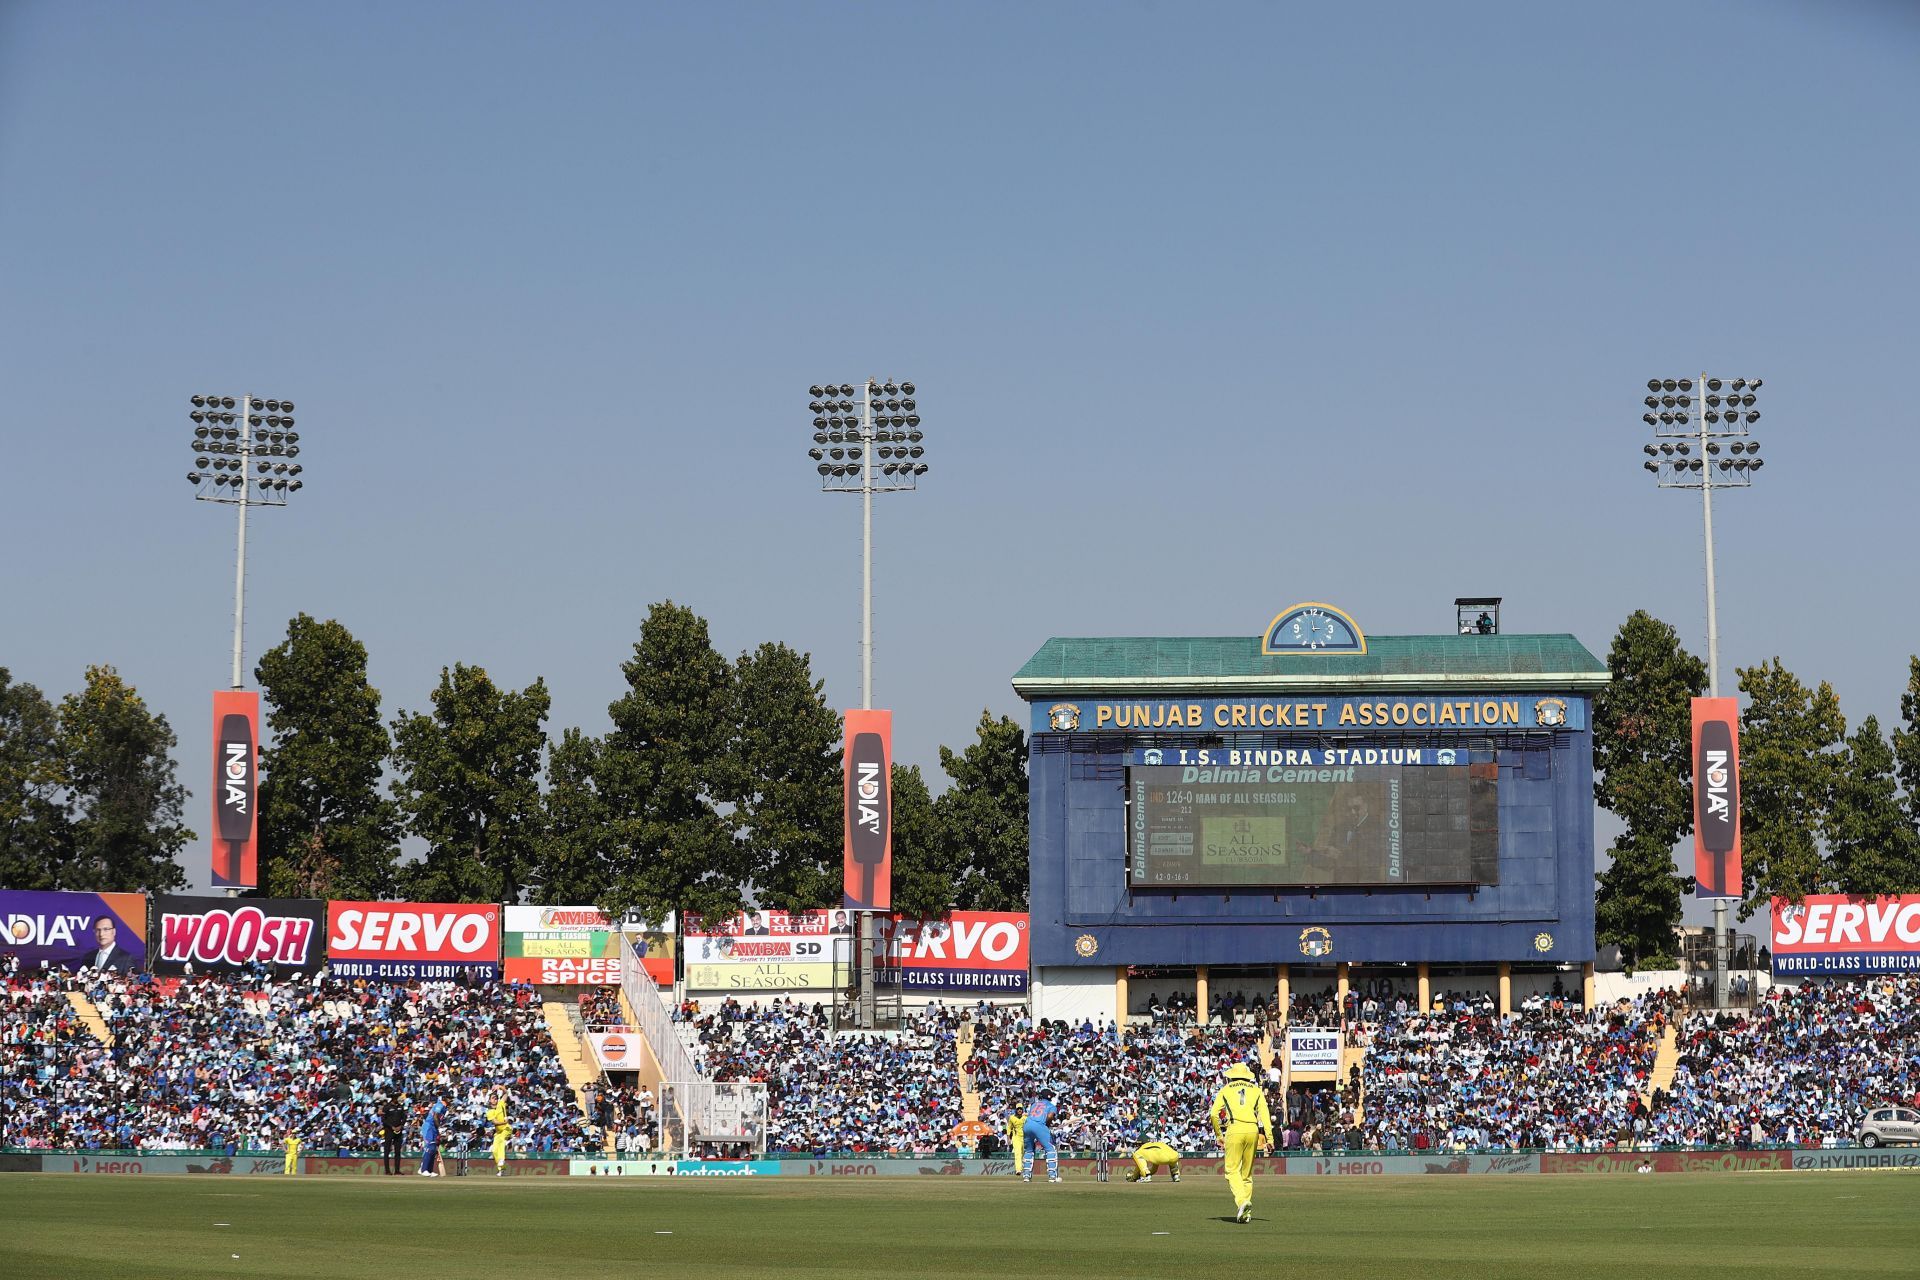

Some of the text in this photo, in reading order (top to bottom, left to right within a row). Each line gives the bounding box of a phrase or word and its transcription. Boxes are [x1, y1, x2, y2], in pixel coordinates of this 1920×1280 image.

[1310, 608, 1317, 616] 12
[1294, 624, 1334, 633] 9 3
[1097, 702, 1519, 727] PUNJAB CRICKET ASSOCIATION
[1179, 749, 1421, 765] I.S. BINDRA STADIUM
[225, 743, 247, 815] INDIA TV
[1182, 766, 1354, 783] Dalmia Cement
[1706, 750, 1729, 823] INDIA TV
[858, 762, 880, 835] INDIA TV
[1166, 791, 1193, 804] 126-0
[1195, 792, 1297, 804] MAN OF ALL SEASONS
[1135, 780, 1145, 878] Dalmia Cement
[1388, 778, 1400, 877] Dalmia Cement
[1229, 835, 1260, 844] ALL
[1206, 844, 1282, 857] SEASONS
[0, 914, 91, 946] NDIA TV
[161, 906, 313, 965] WOOSH
[331, 909, 490, 953] SERVO
[523, 932, 538, 940] MAN
[539, 932, 547, 940] OF
[544, 948, 587, 956] SEASONS
[729, 942, 822, 957] AMBA SD
[333, 963, 416, 977] WORLD-CLASS
[542, 958, 621, 971] RAJES
[754, 964, 786, 975] ALL
[1778, 956, 1920, 970] WORLD-CLASS LUBRICAN
[730, 974, 809, 988] SEASONS
[873, 971, 1021, 987] ORLD-CLASS LUBRICANTS
[1298, 1039, 1331, 1050] KENT
[1238, 1088, 1245, 1106] 1
[1820, 1154, 1896, 1168] HYUNDAI
